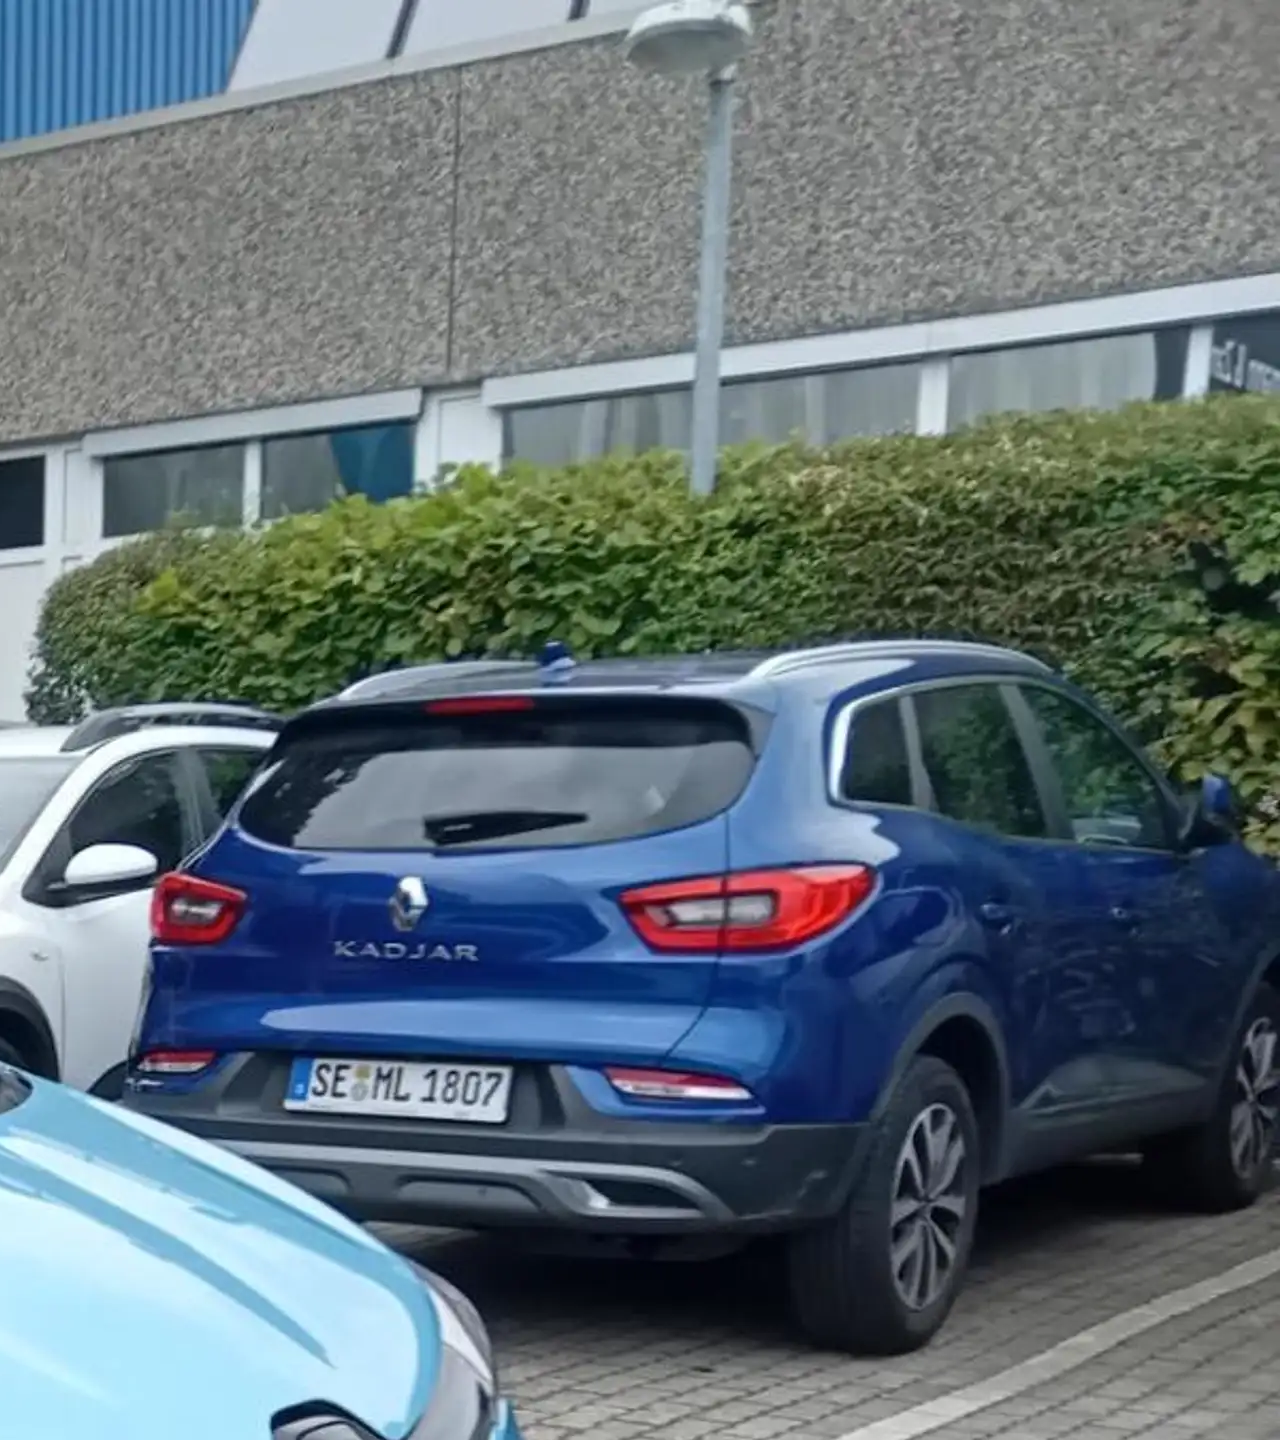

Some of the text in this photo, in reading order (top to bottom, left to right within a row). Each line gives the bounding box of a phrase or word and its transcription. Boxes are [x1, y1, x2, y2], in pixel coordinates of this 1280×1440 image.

[333, 940, 479, 963] KADJAR
[311, 1063, 507, 1108] SE ML 1807
